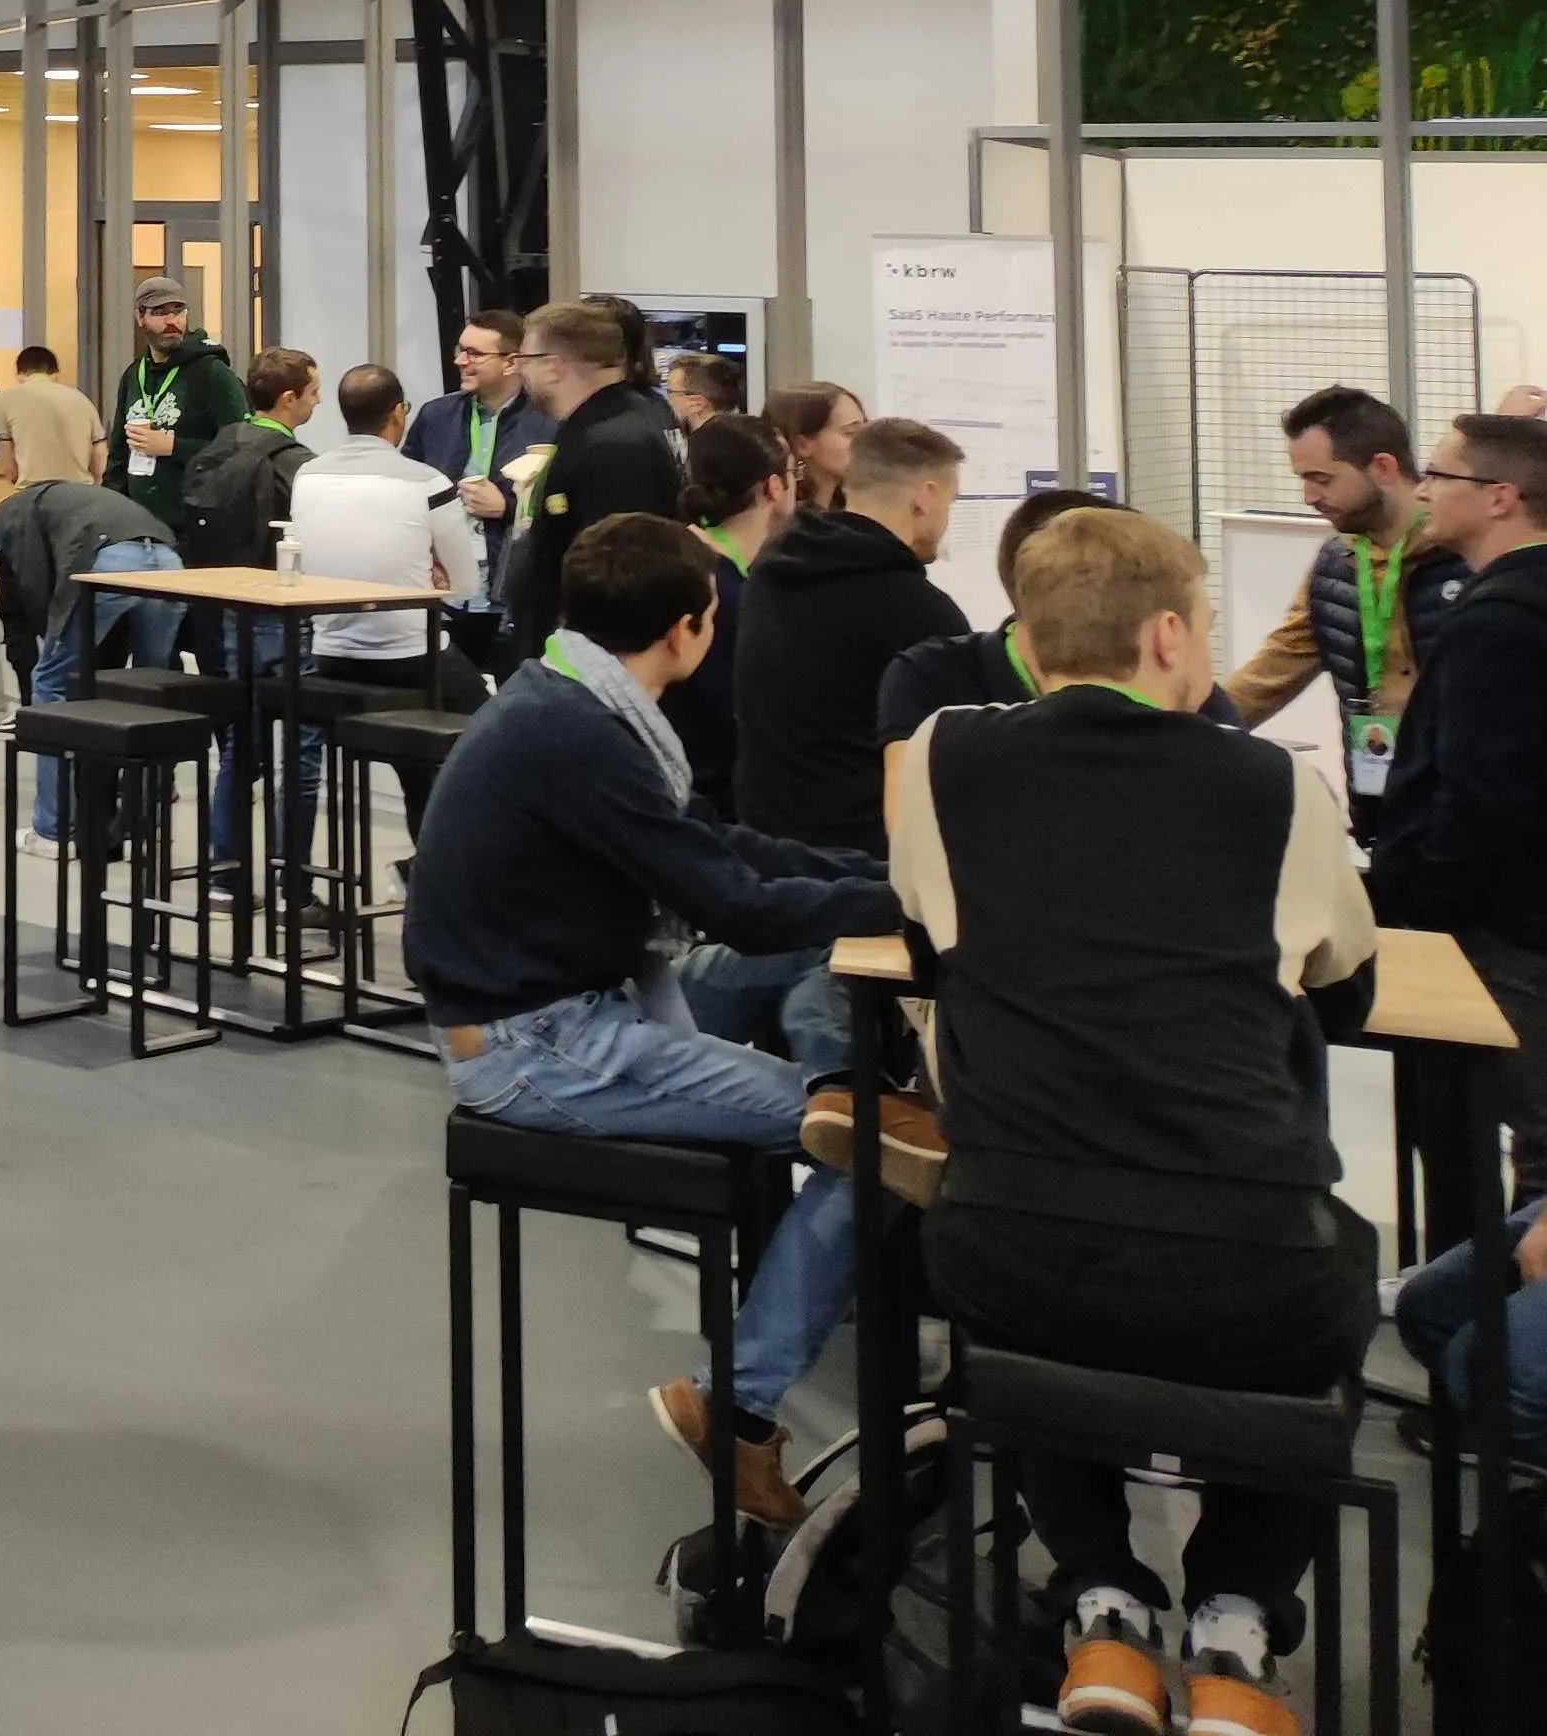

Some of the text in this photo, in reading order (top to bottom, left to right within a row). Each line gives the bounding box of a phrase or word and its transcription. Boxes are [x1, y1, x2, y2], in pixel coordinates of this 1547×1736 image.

[903, 264, 957, 279] kbrw
[888, 308, 923, 321] SaaS
[975, 310, 1055, 324] Performan
